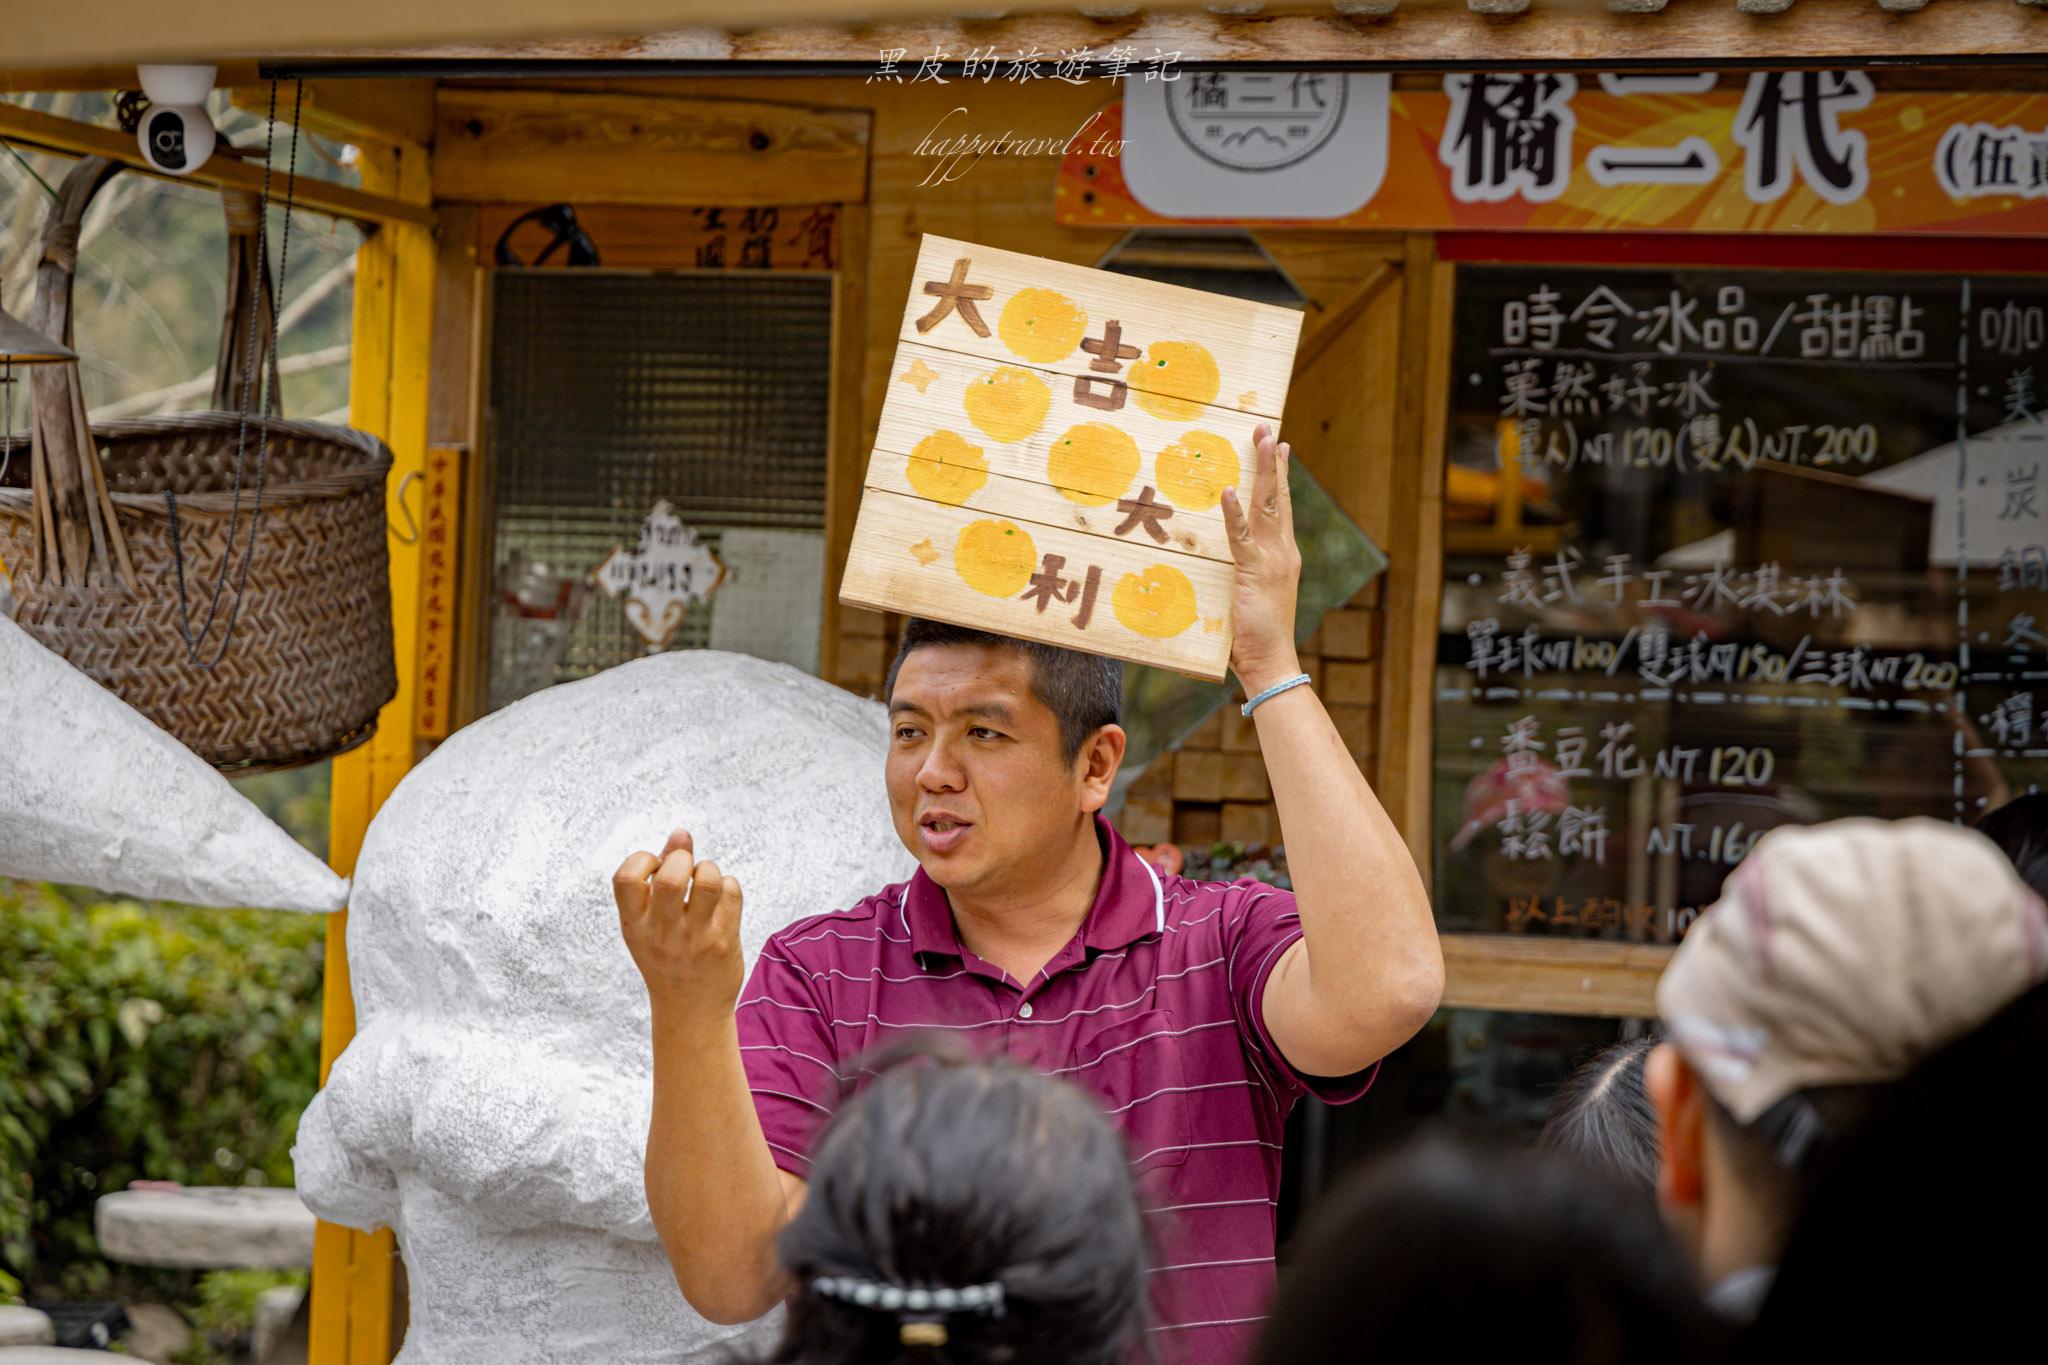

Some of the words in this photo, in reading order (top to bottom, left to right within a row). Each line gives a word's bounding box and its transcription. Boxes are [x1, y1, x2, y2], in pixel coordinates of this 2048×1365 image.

[1502, 284, 1925, 361] 時令冰品/甜點
[1500, 546, 1857, 619] 義式手工冰淇淋
